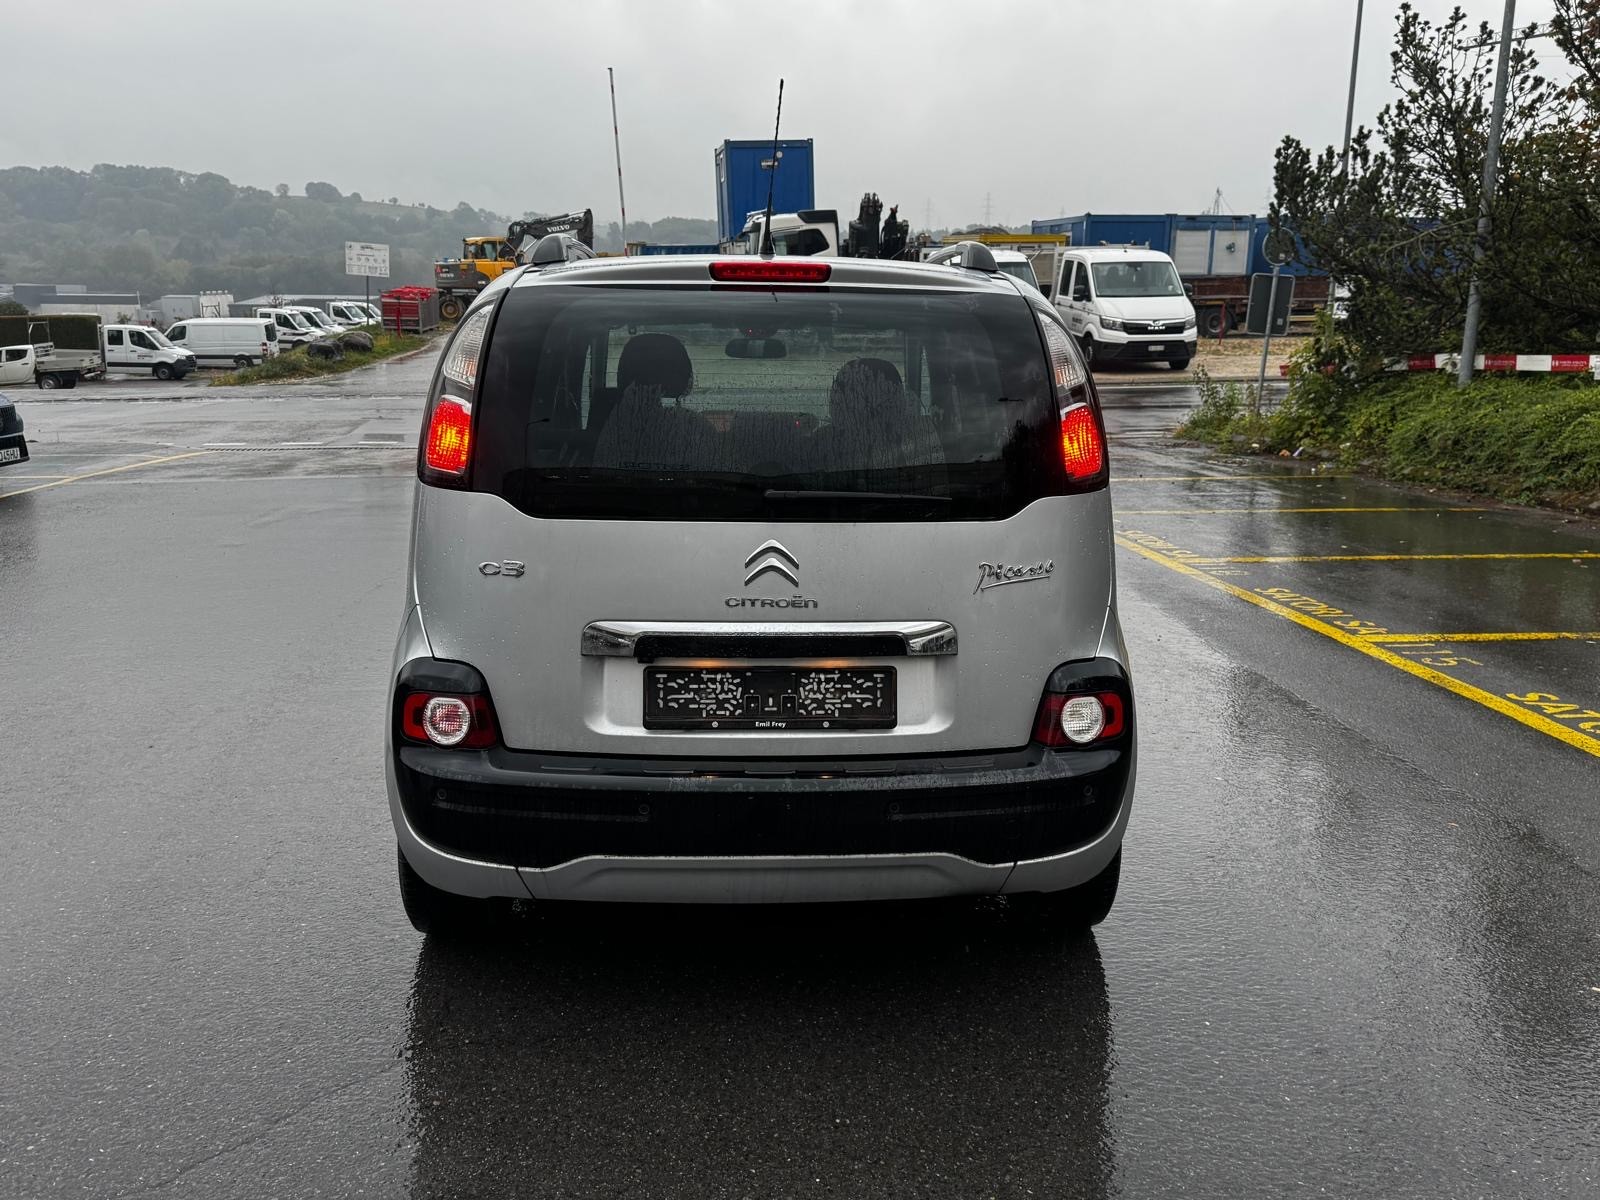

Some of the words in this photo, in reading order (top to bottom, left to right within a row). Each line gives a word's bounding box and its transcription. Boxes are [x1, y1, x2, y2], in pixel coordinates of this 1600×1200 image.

[547, 224, 570, 232] VOLVO
[479, 560, 525, 577] C3
[973, 559, 1055, 595] Picasso
[1254, 587, 1353, 617] SATORI
[1385, 643, 1484, 666] 115
[771, 721, 787, 729] Frey
